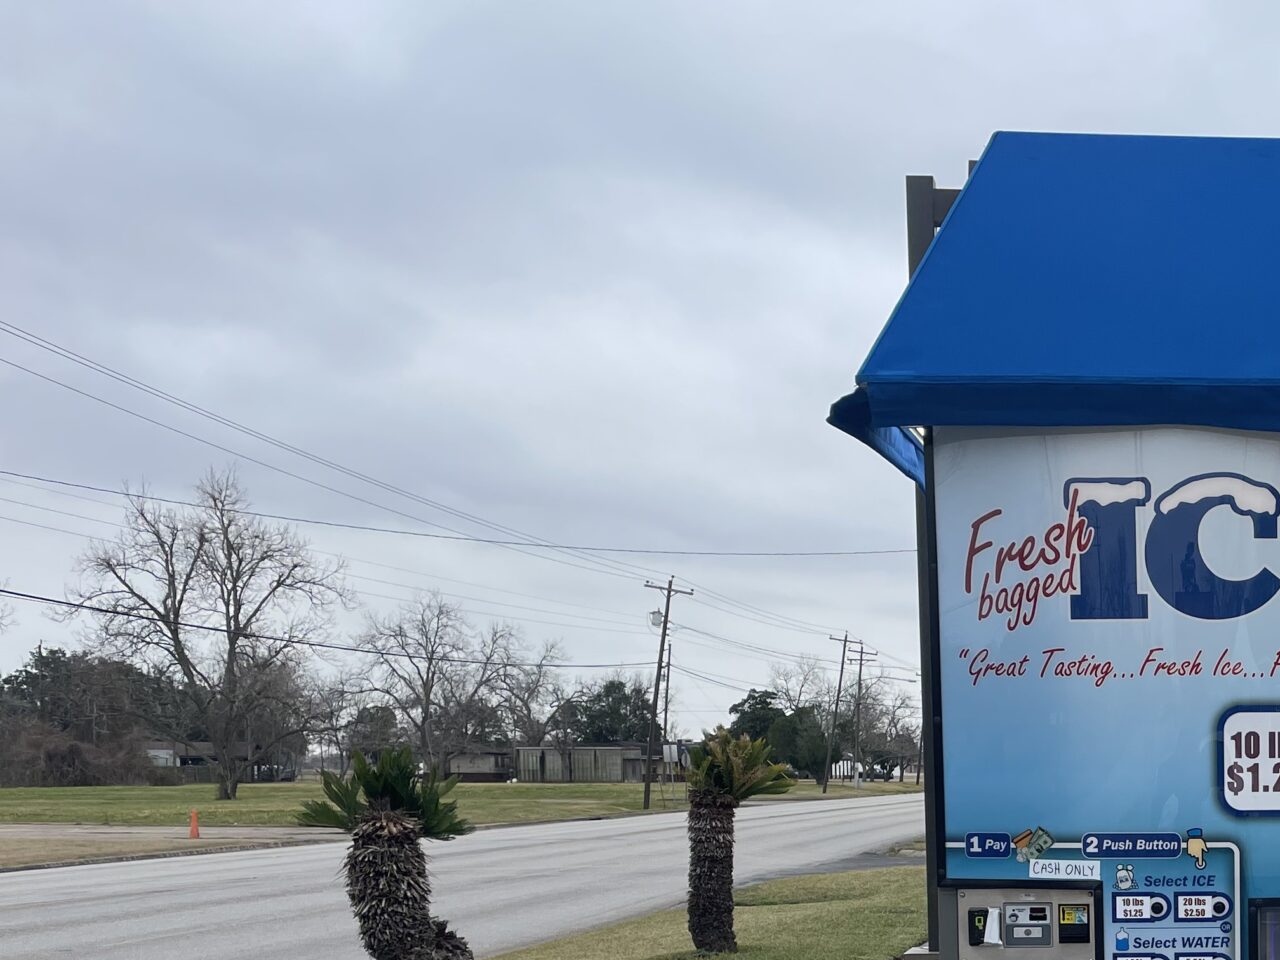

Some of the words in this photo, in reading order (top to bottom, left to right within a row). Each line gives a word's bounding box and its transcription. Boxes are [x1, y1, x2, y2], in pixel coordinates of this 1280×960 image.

[964, 488, 1094, 593] Fresh
[979, 553, 1077, 631] bagged
[1230, 731, 1260, 759] 10
[970, 836, 982, 852] 1
[985, 838, 1007, 852] Pay
[1085, 836, 1099, 853] 2
[1102, 838, 1133, 850] Push
[1136, 838, 1178, 850] Button
[1032, 861, 1060, 875] CASH
[1065, 863, 1095, 876] ONLY
[1144, 874, 1188, 887] Select
[1191, 874, 1216, 887] ICE
[1122, 898, 1131, 906] 10
[1132, 898, 1144, 906] lbs
[1183, 897, 1193, 906] 20
[1194, 897, 1206, 906] lbs
[1123, 908, 1144, 917] $1.25
[1184, 908, 1206, 917] $2.50
[1133, 937, 1177, 949] Select
[1182, 936, 1230, 948] WATER
